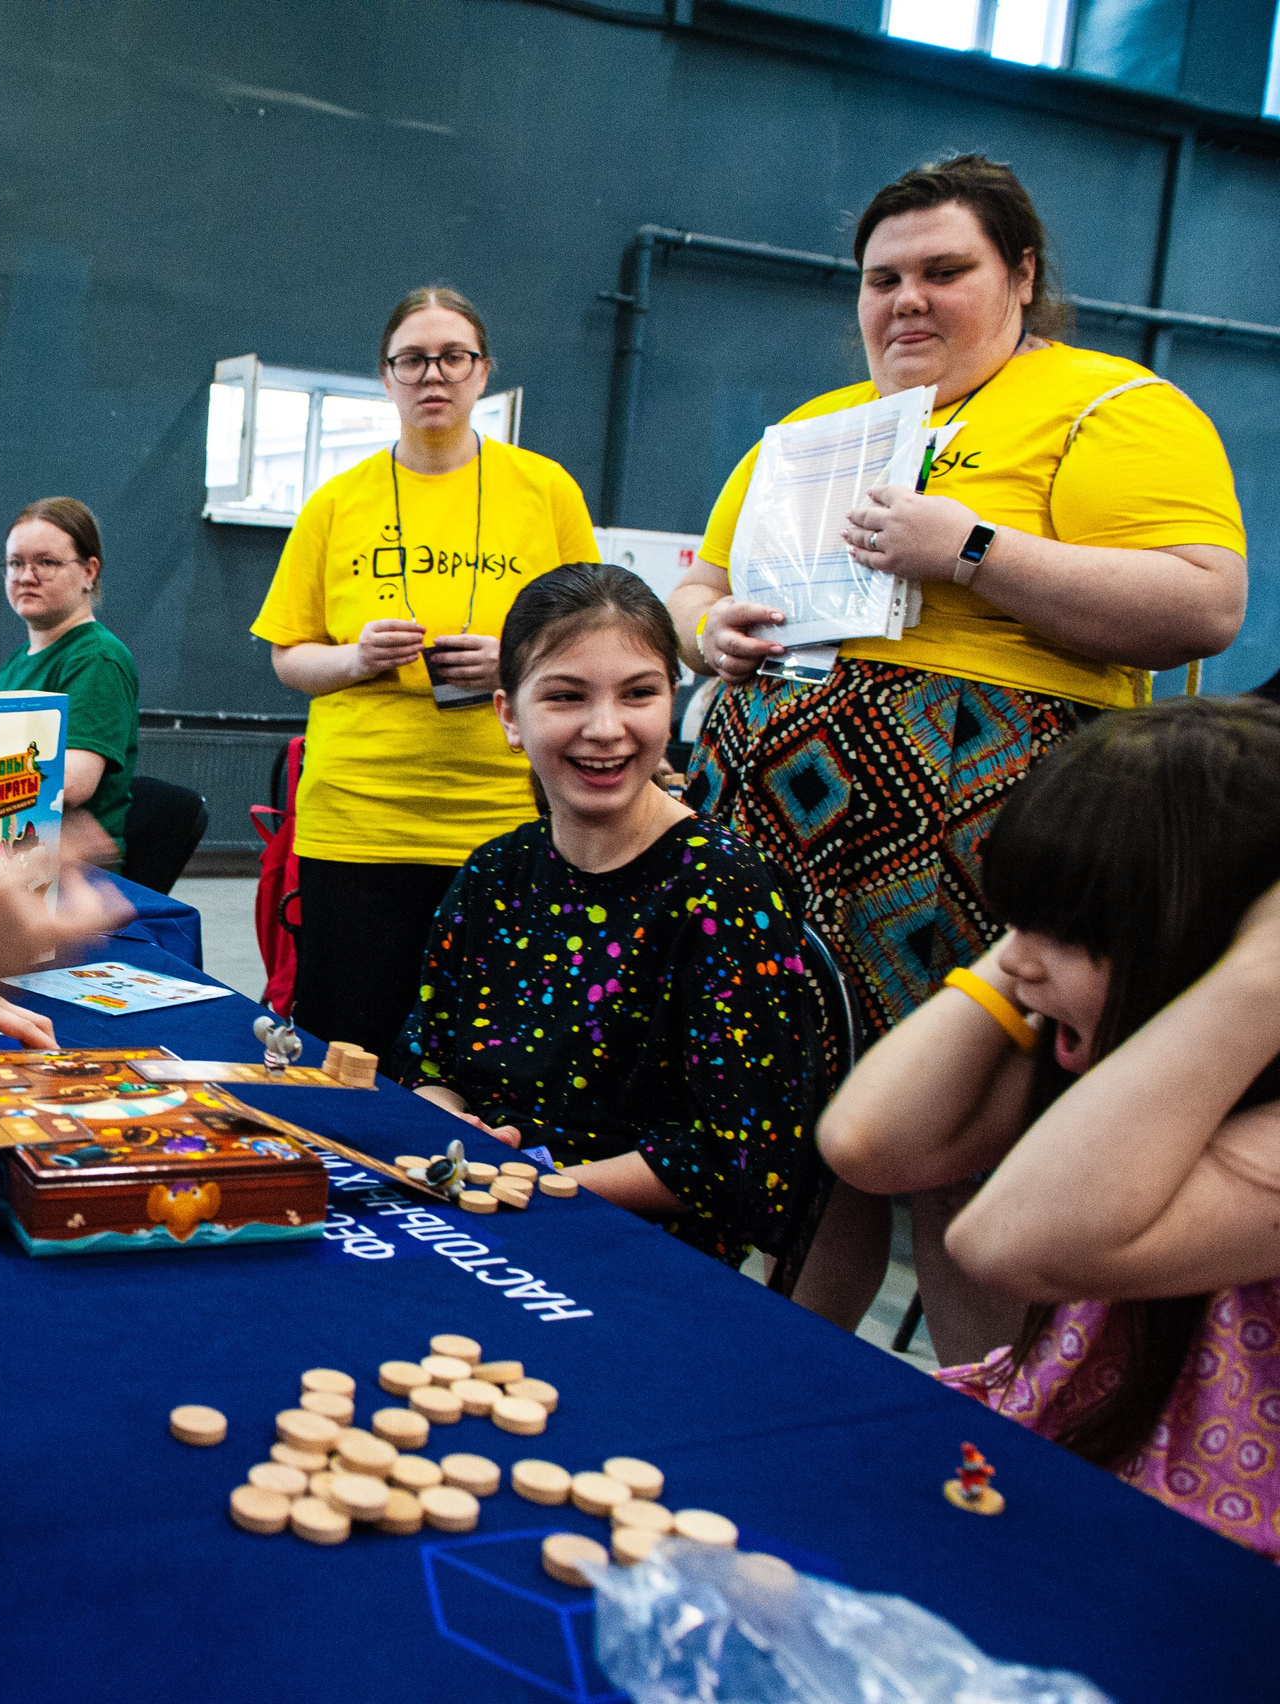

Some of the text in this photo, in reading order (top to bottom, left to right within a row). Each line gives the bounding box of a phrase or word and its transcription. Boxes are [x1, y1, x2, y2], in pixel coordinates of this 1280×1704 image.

[412, 545, 521, 580] Эврикус
[322, 1204, 396, 1260] ФЕС
[328, 1171, 594, 1322] НАСТОЛЬНЫХ
